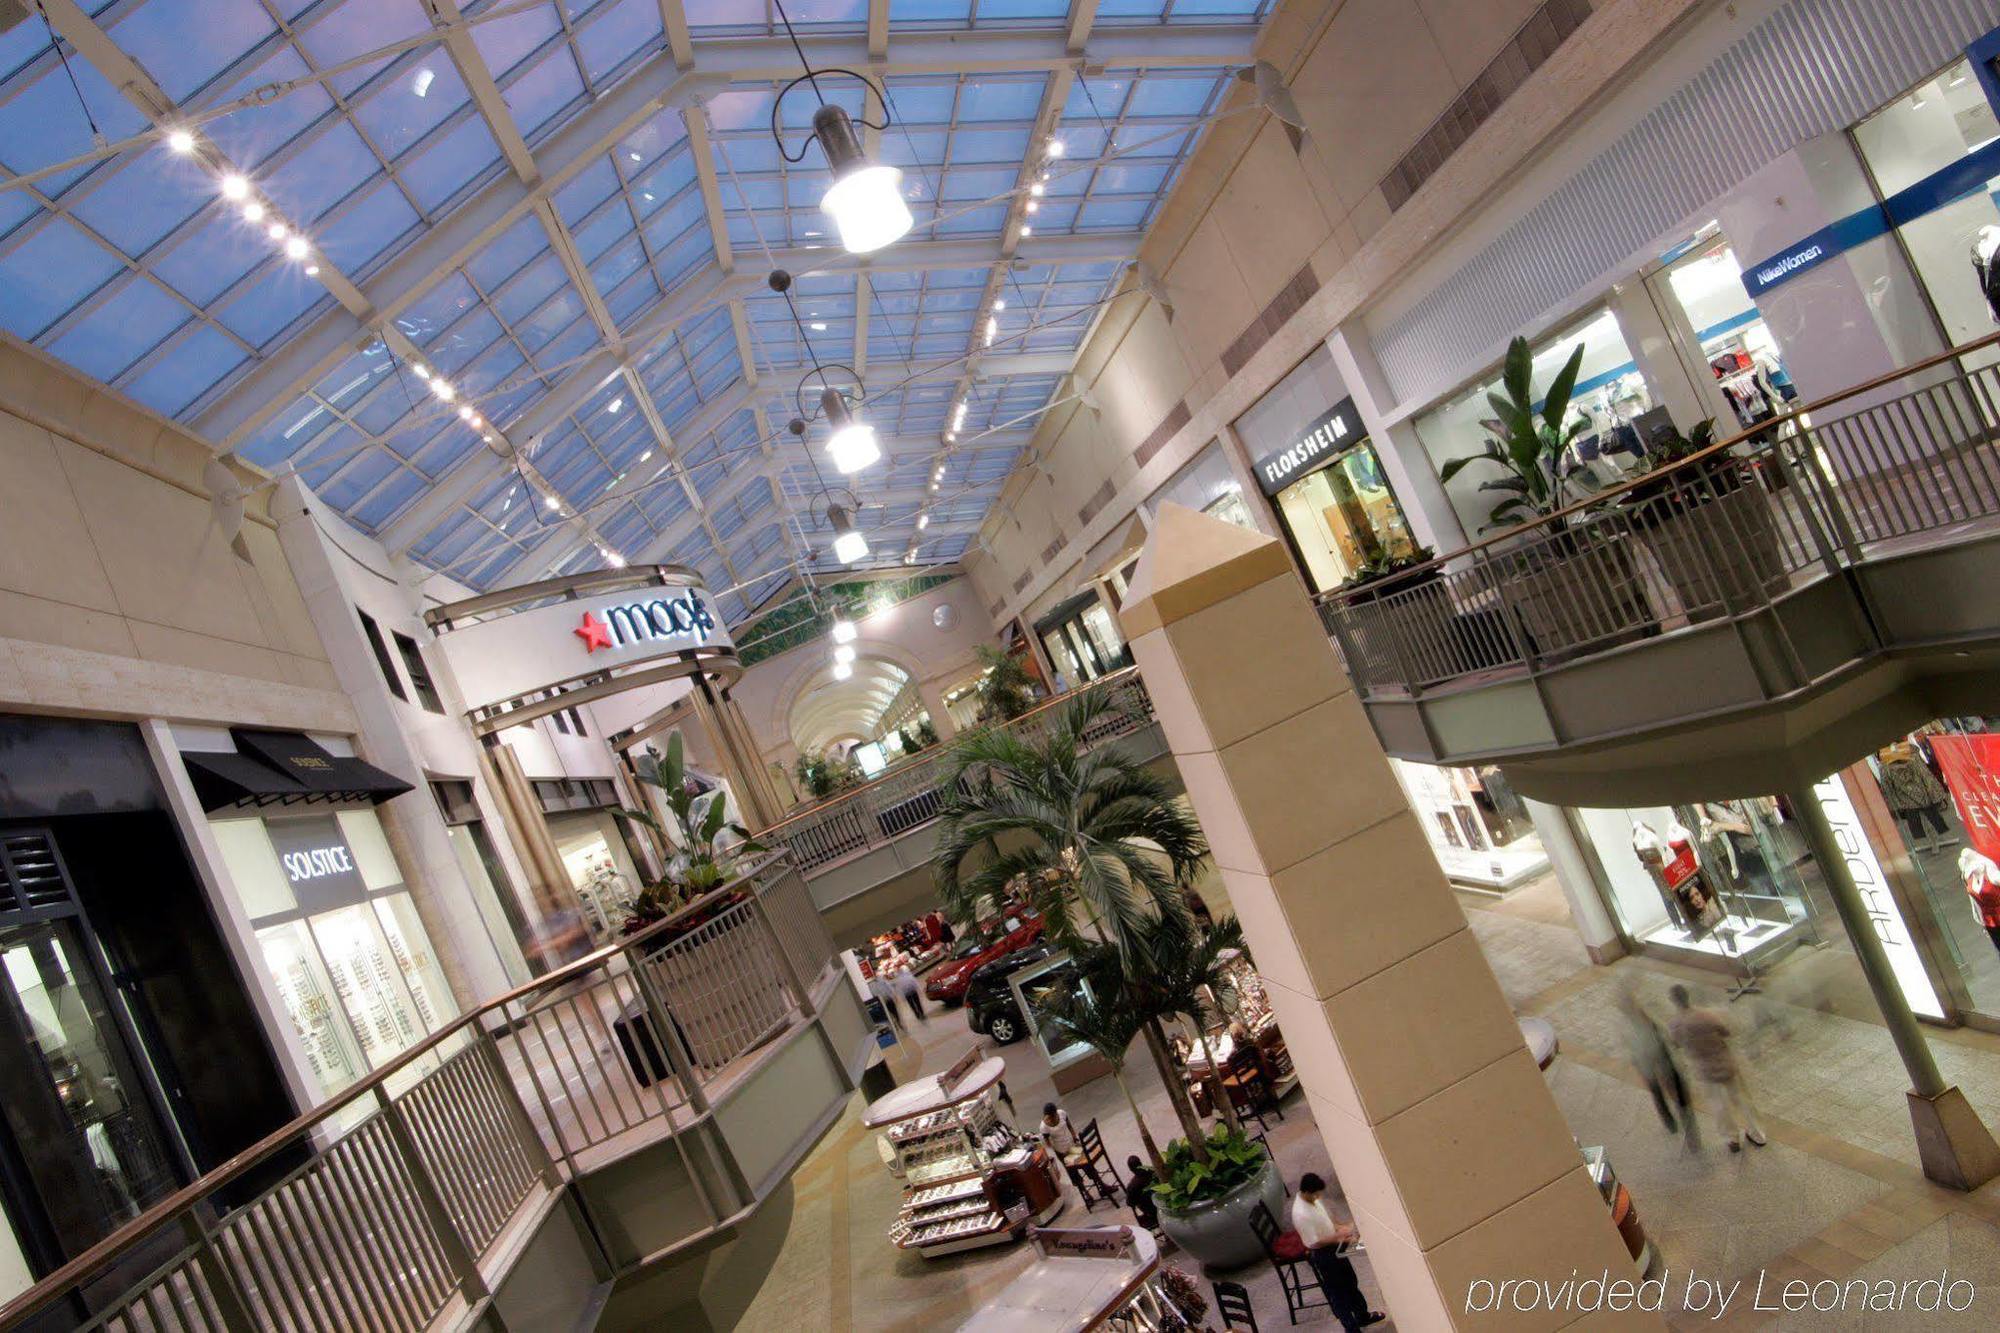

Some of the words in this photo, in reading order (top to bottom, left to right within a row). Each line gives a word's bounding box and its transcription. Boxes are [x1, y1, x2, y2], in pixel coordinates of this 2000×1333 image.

[1757, 245, 1822, 286] NikeWomen
[1265, 415, 1348, 483] FLORSHEIM
[283, 845, 353, 882] SOLSTICE
